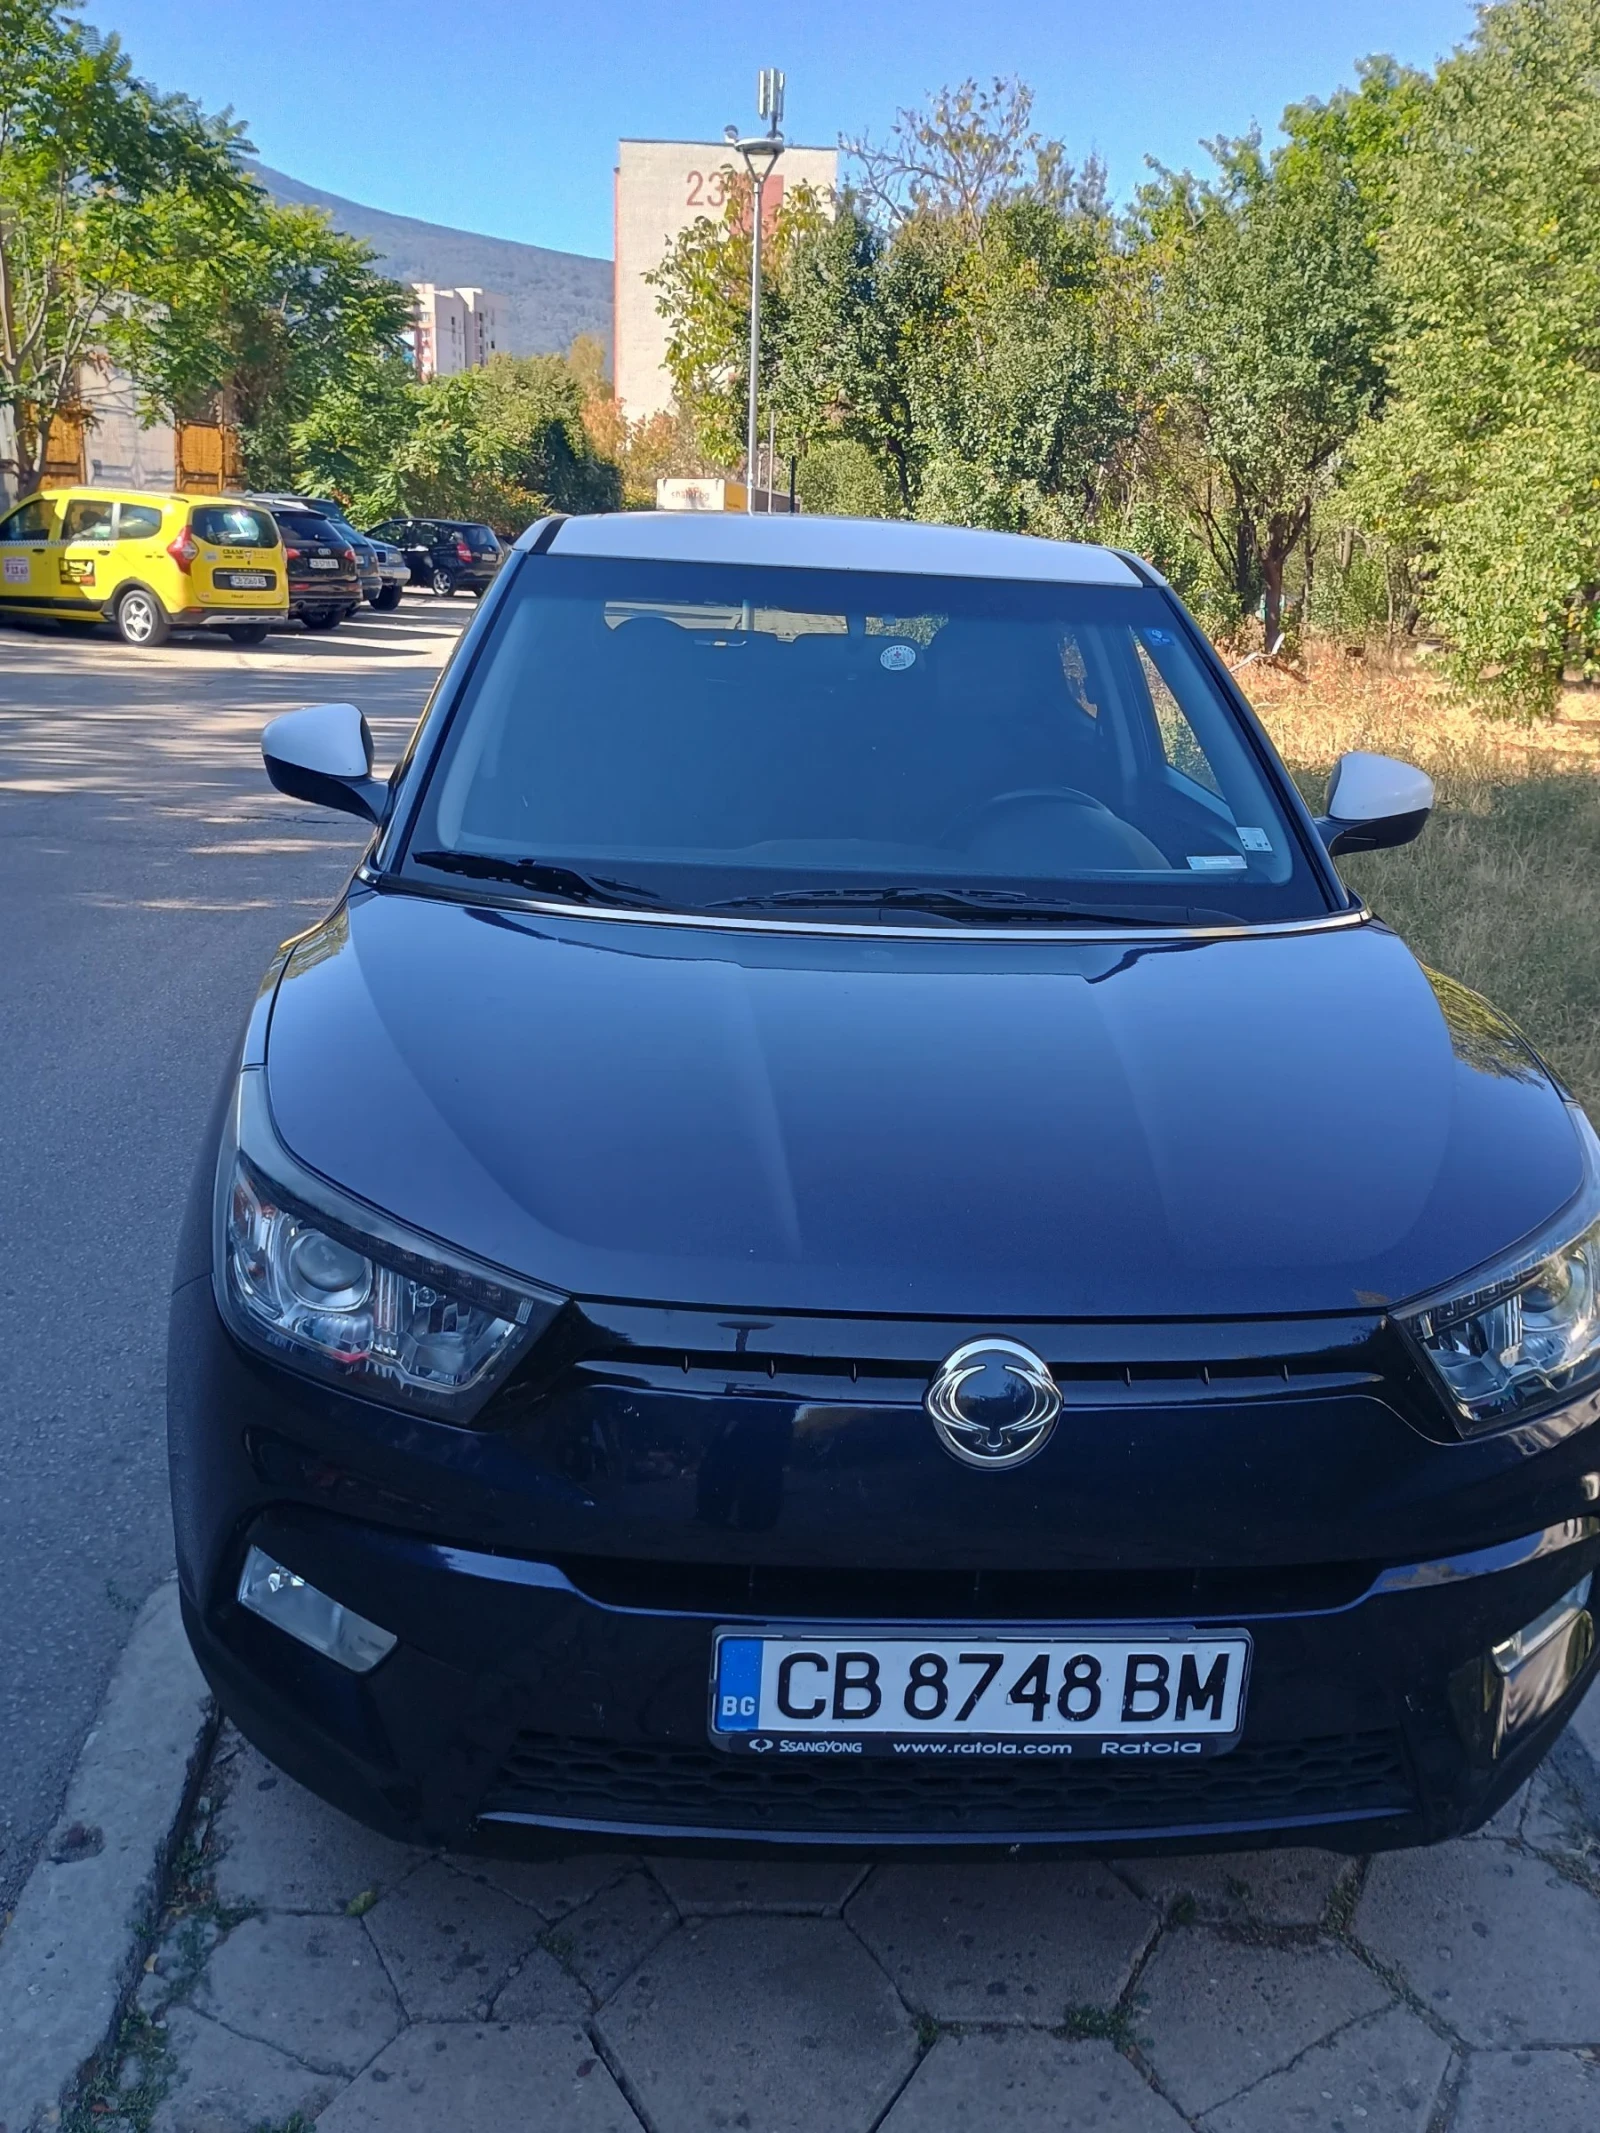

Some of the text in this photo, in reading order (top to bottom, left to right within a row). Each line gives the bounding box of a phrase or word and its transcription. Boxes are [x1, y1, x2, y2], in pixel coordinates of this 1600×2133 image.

[686, 170, 725, 207] 23
[777, 1651, 1231, 1722] CB 8748 BM
[721, 1695, 756, 1717] BG
[893, 1740, 1072, 1755] www.ratola.com
[1101, 1740, 1202, 1755] Ratola
